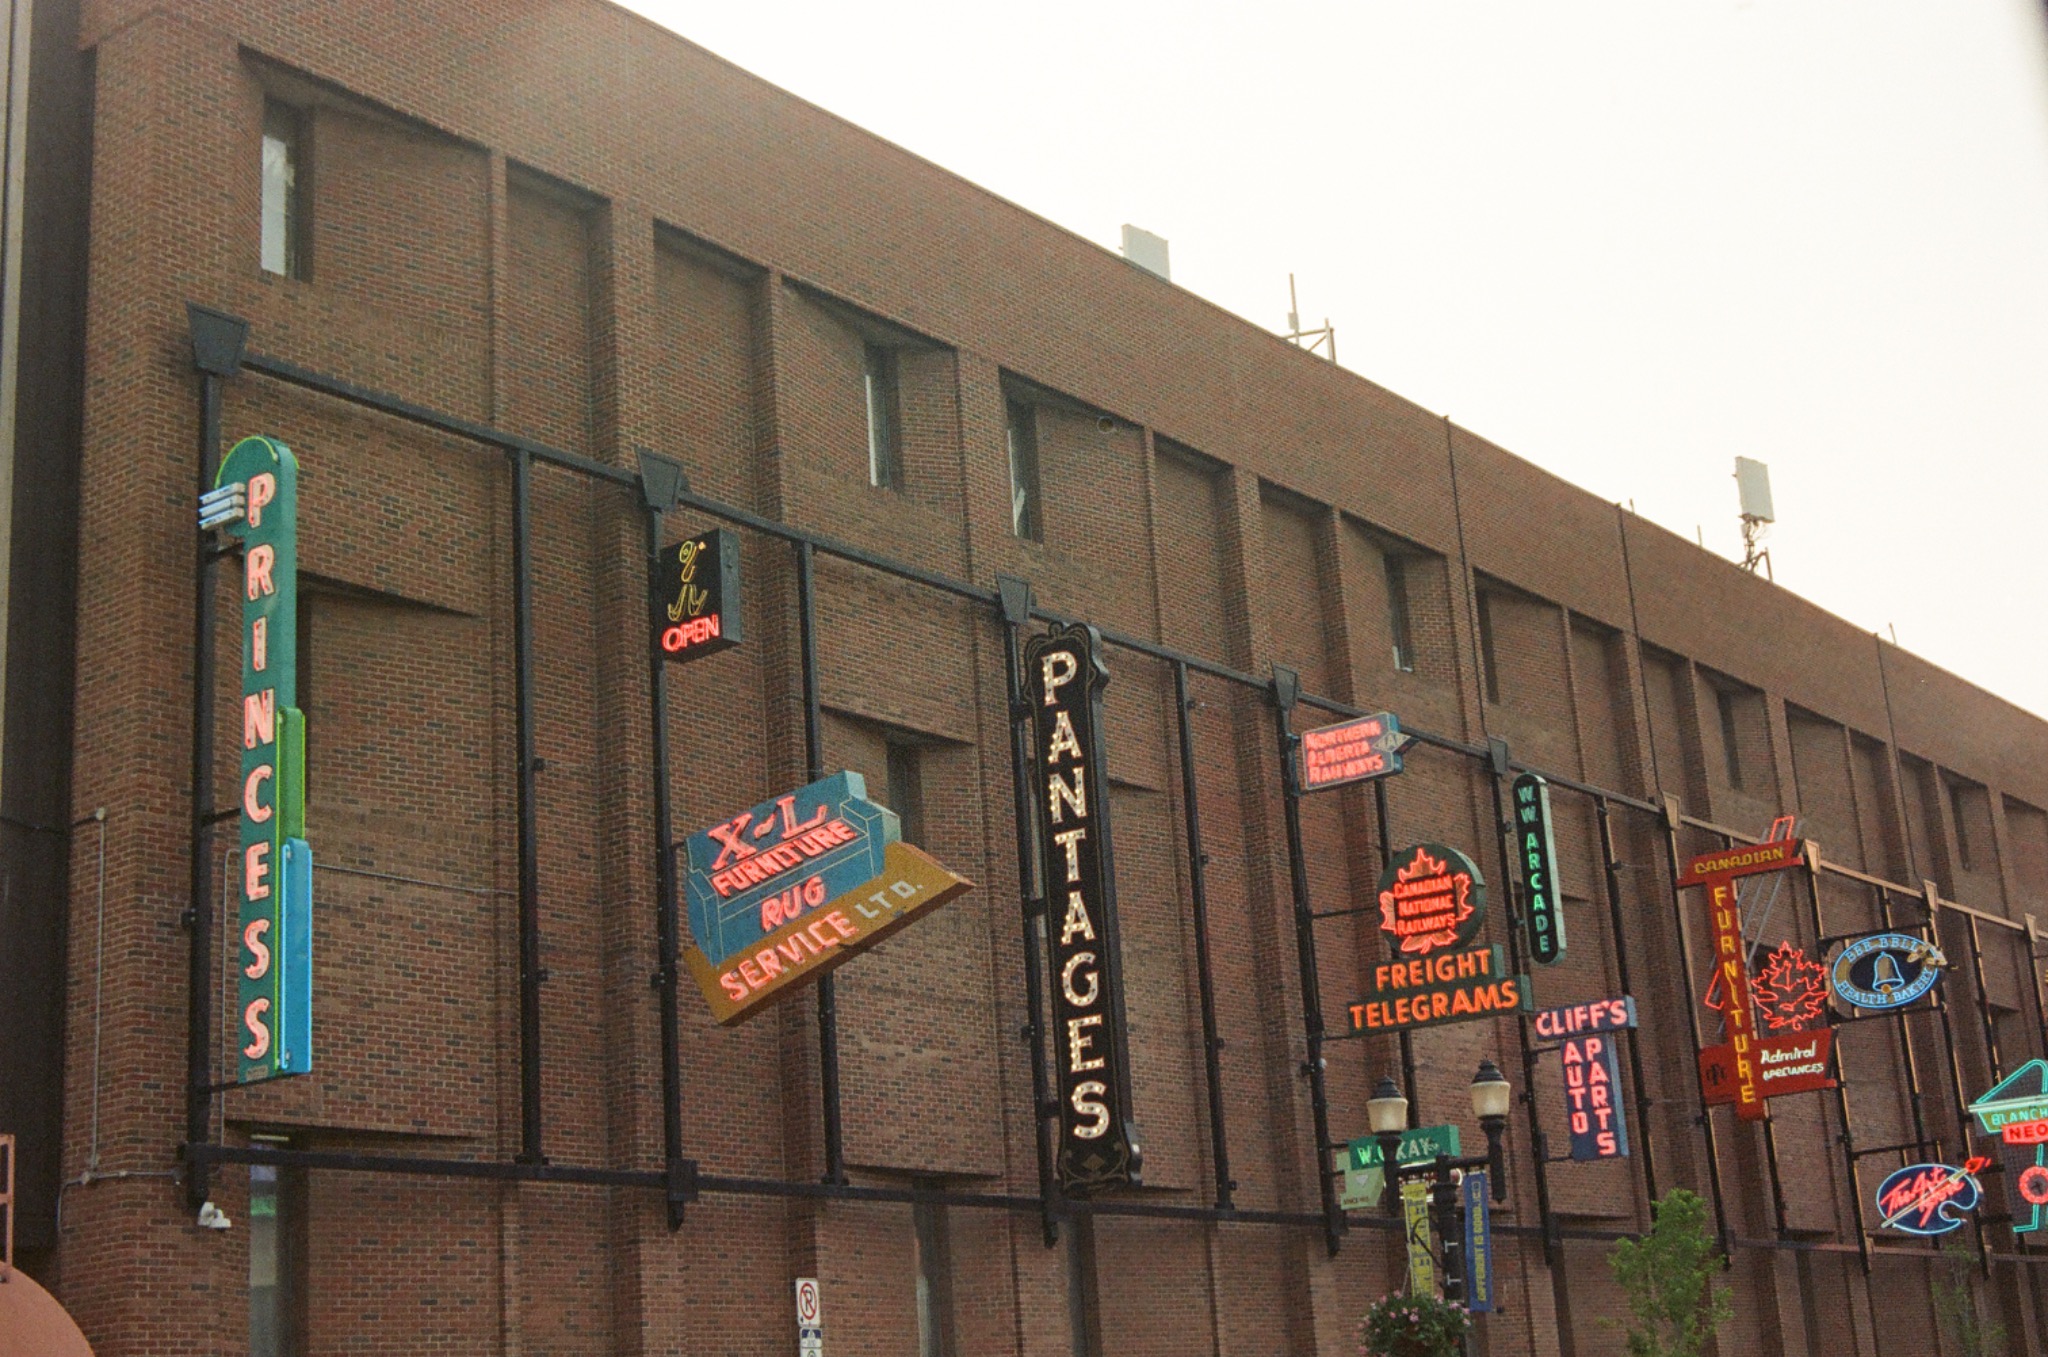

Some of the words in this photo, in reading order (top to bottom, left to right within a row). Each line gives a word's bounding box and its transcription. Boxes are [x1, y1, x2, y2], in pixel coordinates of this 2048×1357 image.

[662, 613, 719, 652] OPEN
[1305, 720, 1382, 750] NORTHERN
[1307, 740, 1371, 767] ALBERTA
[243, 472, 275, 1060] PRINCESS
[1308, 754, 1384, 784] RAILWAYS
[707, 796, 828, 870] X-L
[712, 820, 858, 897] FURNITURE
[1694, 847, 1784, 874] CANADIAN
[761, 875, 826, 932] RUG
[1041, 650, 1109, 1139] PANTAGES
[1393, 874, 1453, 899] CANADIAN
[1398, 894, 1455, 917] NATIONAL
[1526, 832, 1549, 954] ARCADE
[720, 910, 858, 1001] SERVICE
[854, 879, 924, 919] LTD.
[1396, 912, 1456, 937] RAILWAYS
[1375, 948, 1491, 992] FREIGHT
[1838, 980, 1888, 1004] HEALTH
[1892, 966, 1934, 1003] BAKERY
[1349, 980, 1519, 1029] TELEGRAMS
[1714, 886, 1756, 1104] FURNITURE
[1535, 1000, 1628, 1037] CLIFF'S
[1760, 1039, 1817, 1064] Admiral
[1563, 1041, 1589, 1134] AUTO
[1585, 1037, 1617, 1155] PARTS
[2009, 1123, 2048, 1140] NEO
[1473, 1247, 1487, 1302] DIFFERENT
